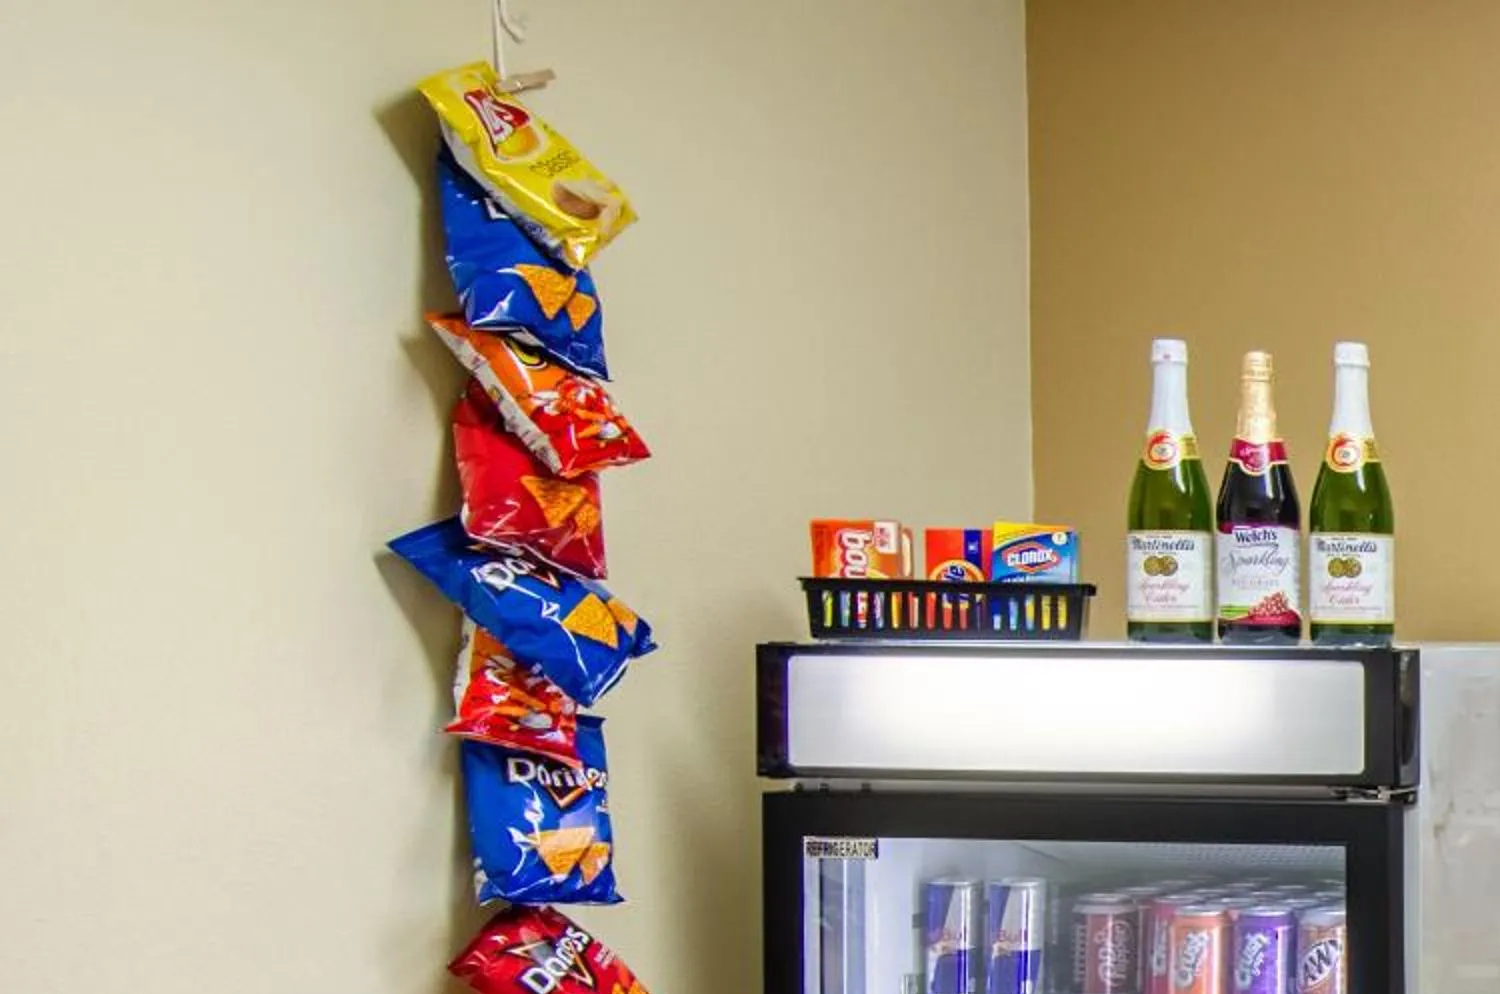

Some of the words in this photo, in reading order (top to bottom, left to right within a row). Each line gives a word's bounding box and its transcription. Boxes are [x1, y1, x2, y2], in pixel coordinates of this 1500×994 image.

[1131, 535, 1196, 552] Martinelli's
[1235, 529, 1278, 545] Welch's
[1316, 537, 1379, 554] Martinelli's
[1007, 548, 1054, 567] CLOROX
[1176, 930, 1208, 988] Crush
